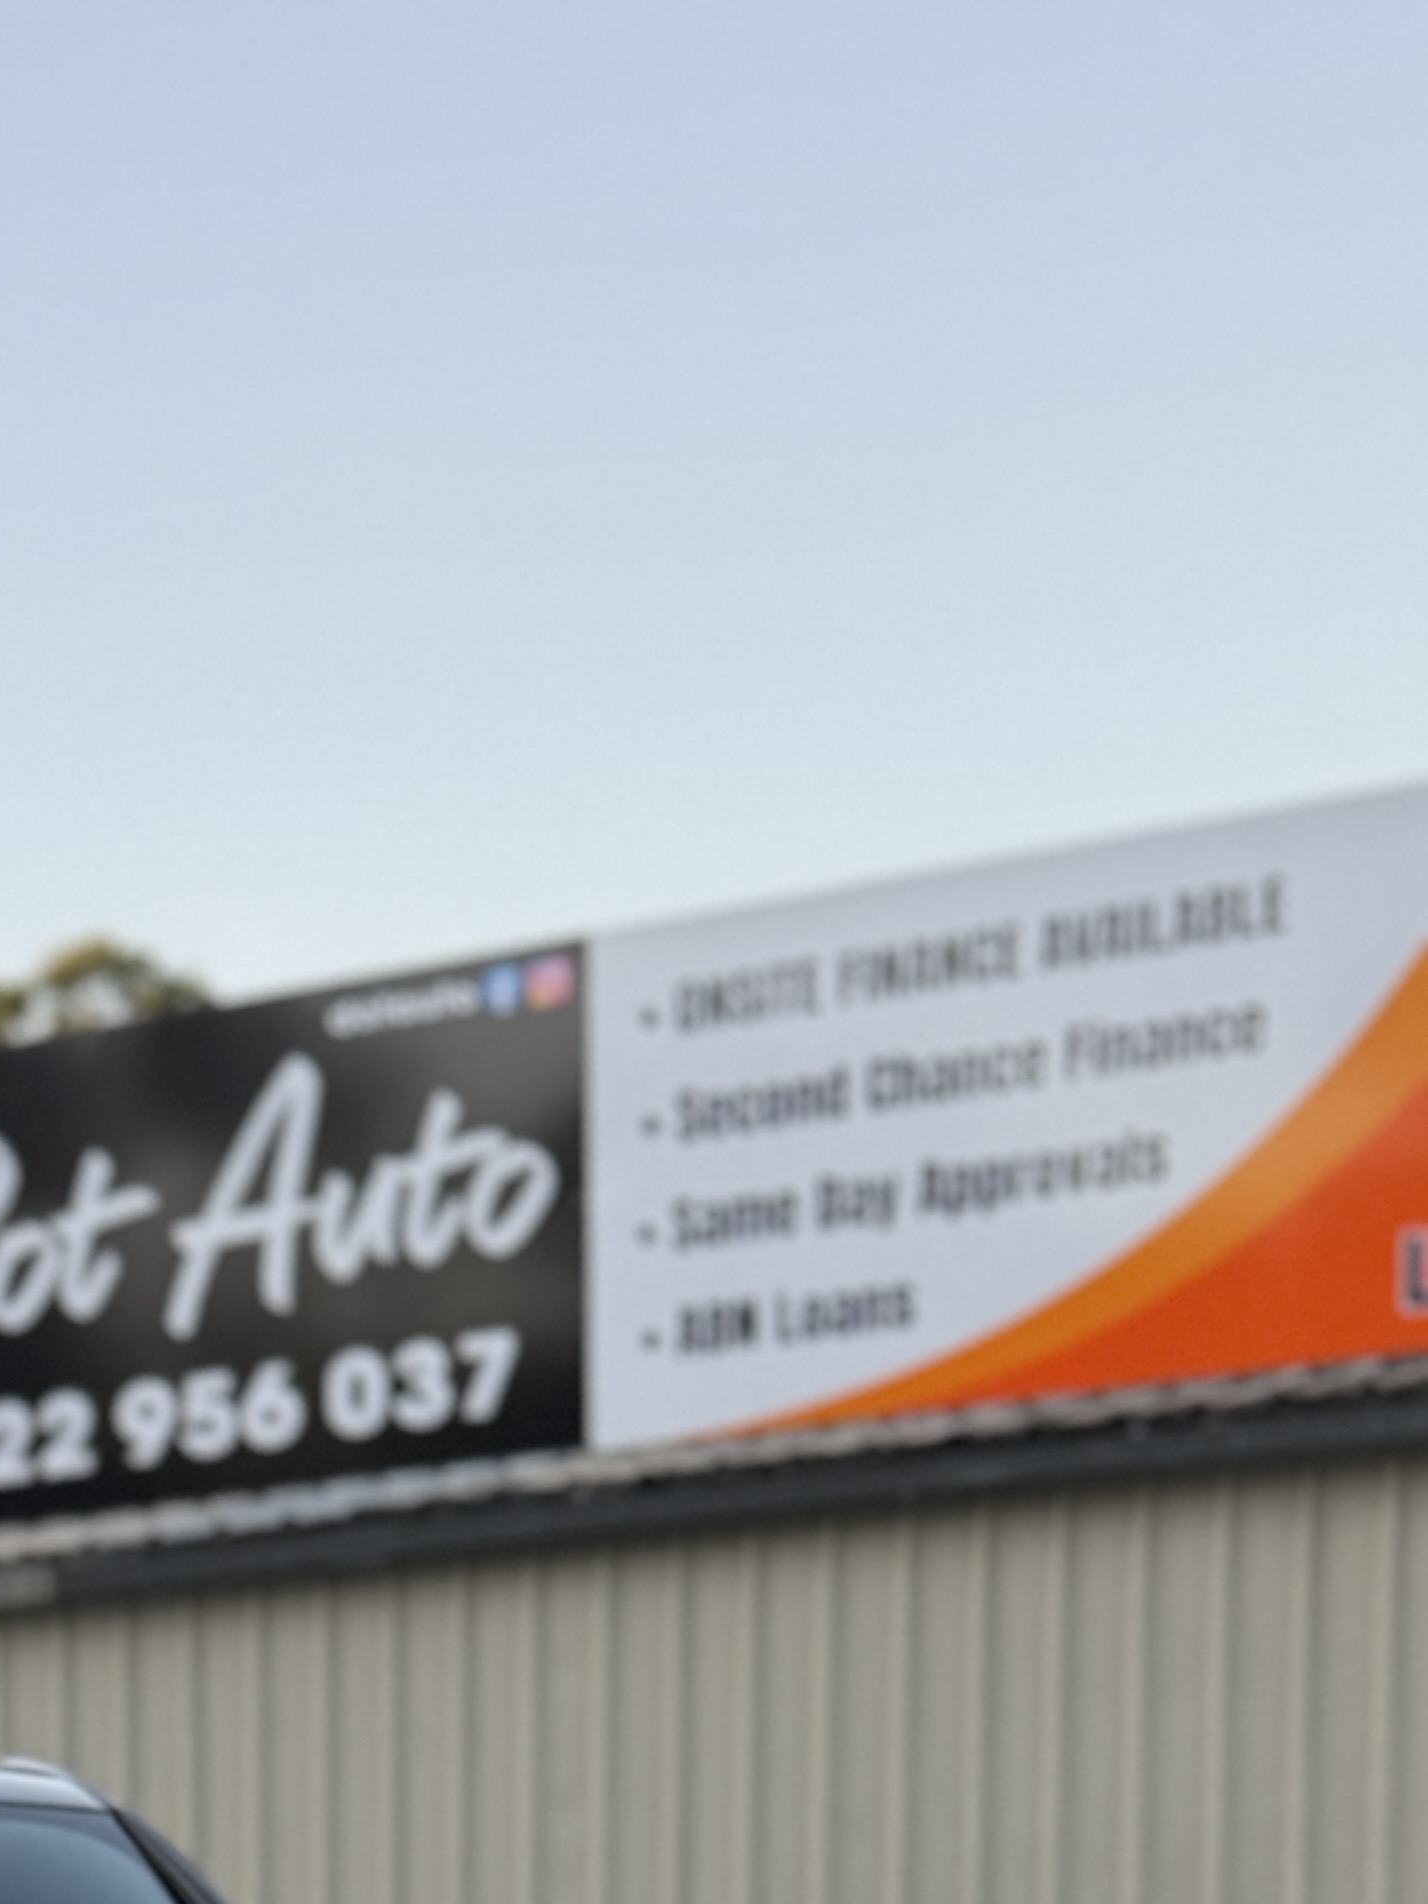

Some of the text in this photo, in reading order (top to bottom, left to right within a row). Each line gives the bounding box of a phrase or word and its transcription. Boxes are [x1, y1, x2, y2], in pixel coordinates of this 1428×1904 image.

[670, 874, 1290, 1036] ONSITE FINANCE AVAILABLE
[670, 998, 1270, 1146] Second Chance Finance
[160, 1048, 561, 1342] Auto
[668, 1129, 1171, 1257] Same Day Approvals
[674, 1278, 919, 1363] ABN Loans
[110, 1354, 309, 1471] 956
[319, 1324, 523, 1444] 037
